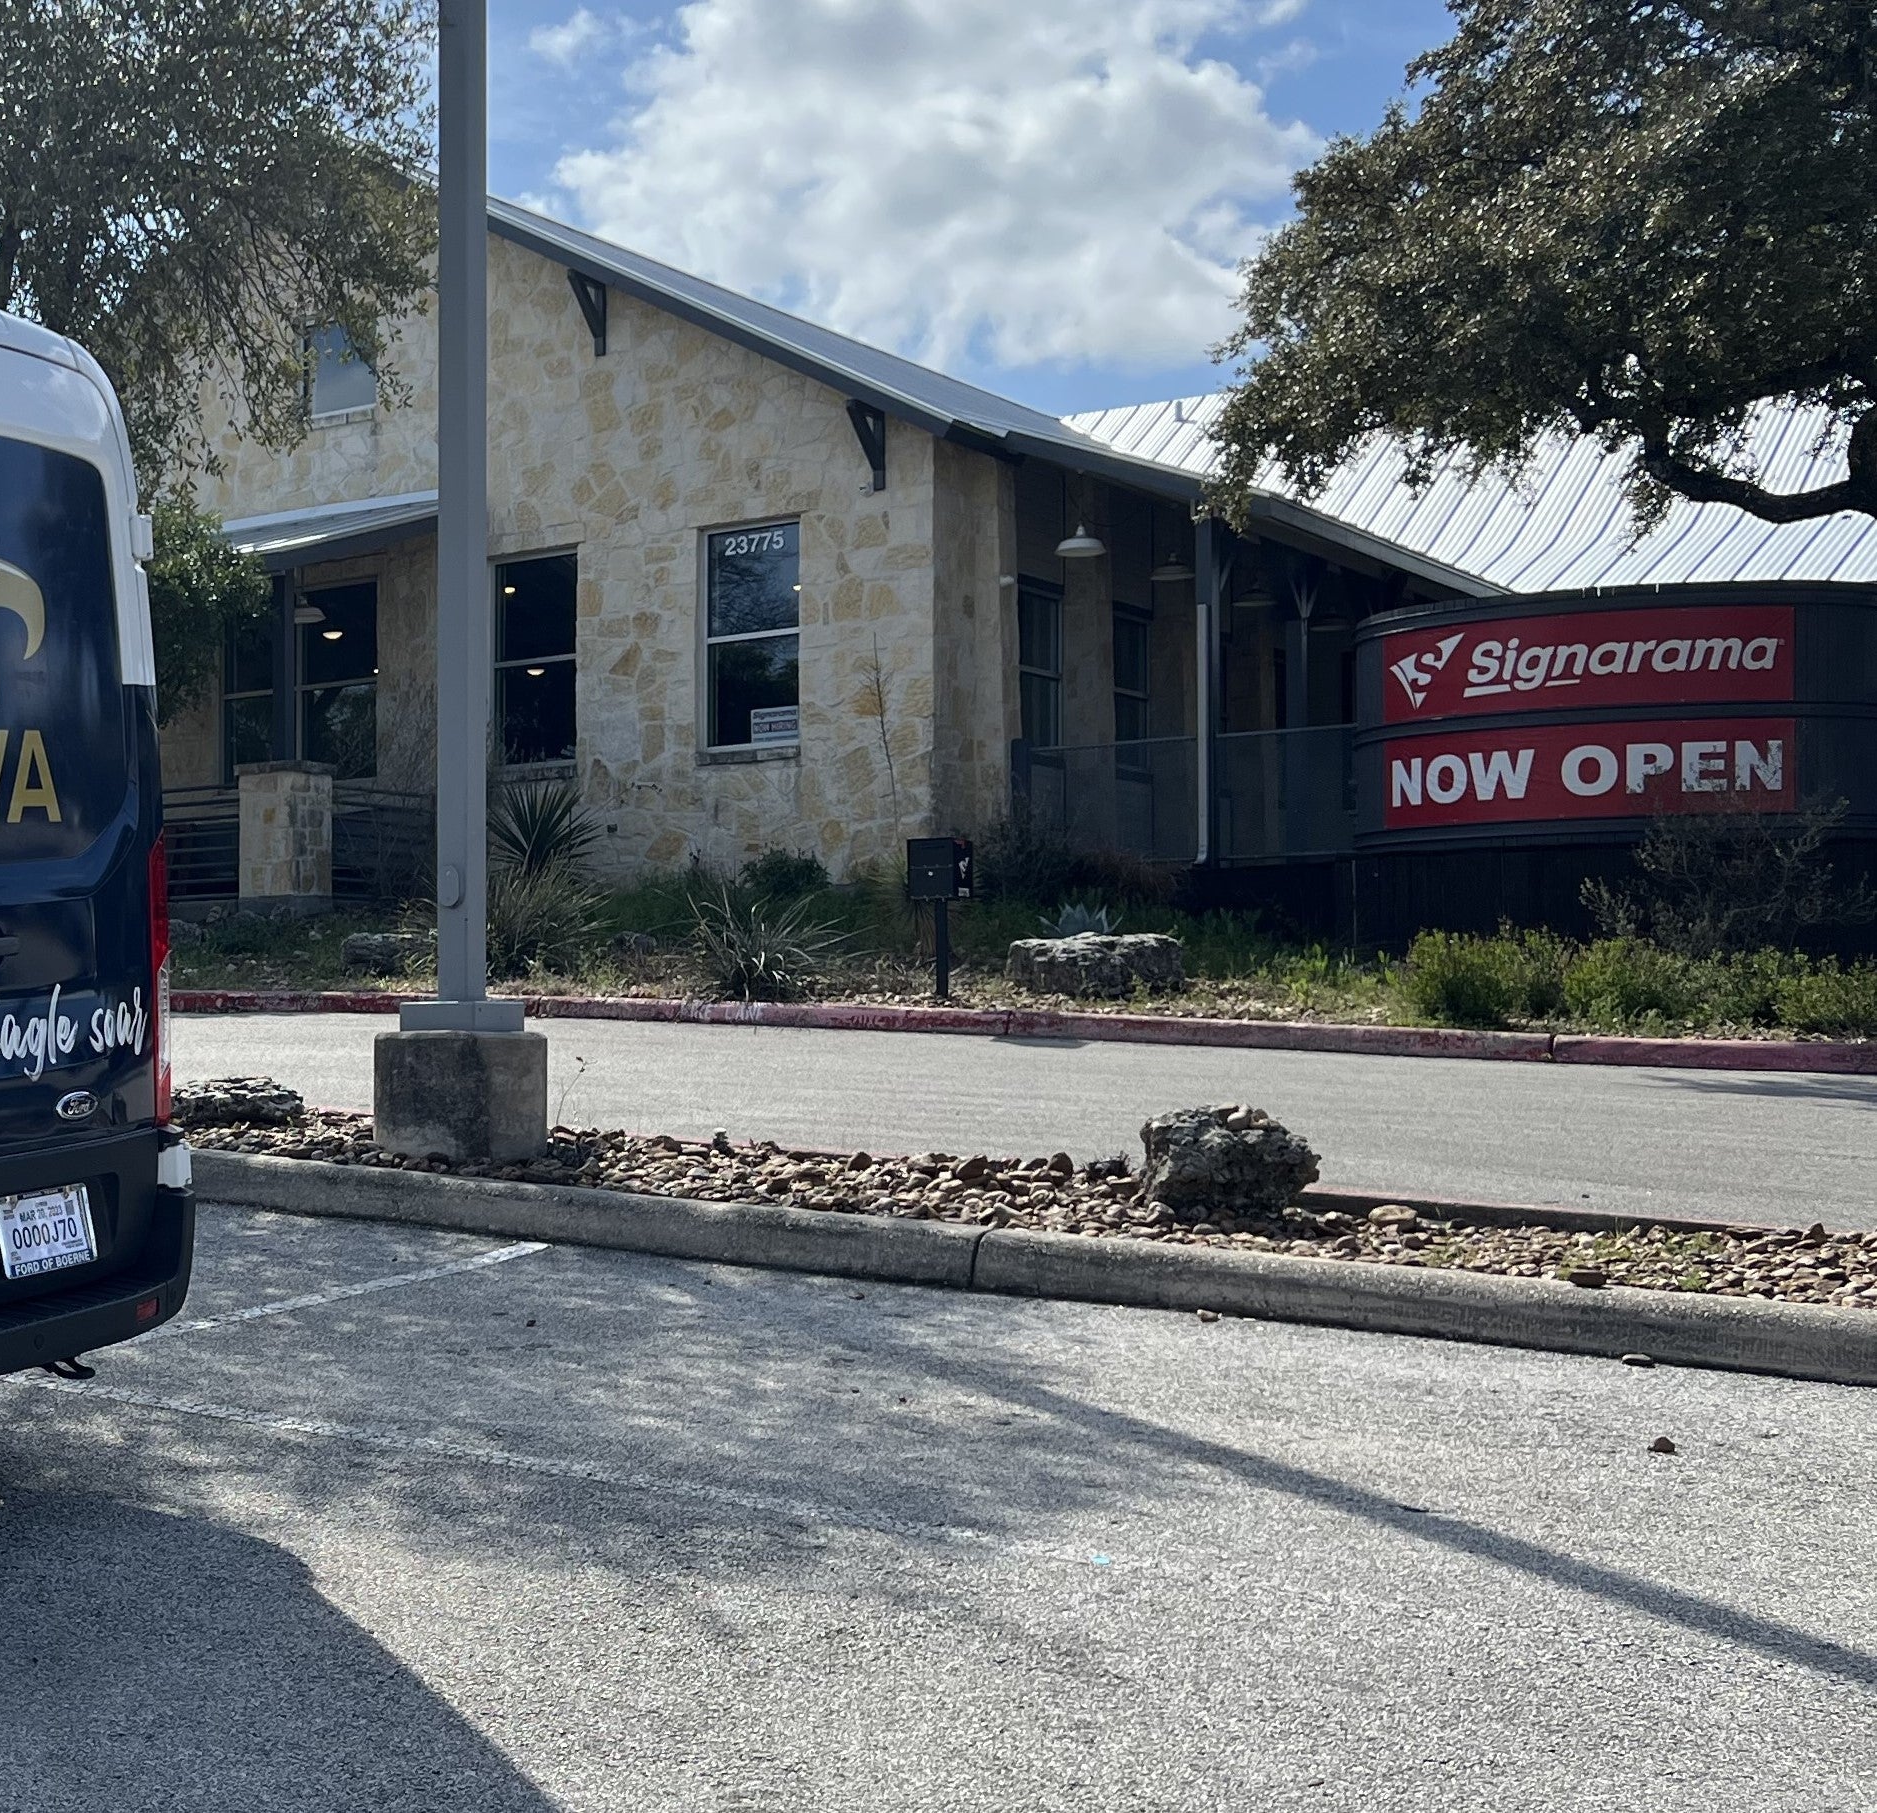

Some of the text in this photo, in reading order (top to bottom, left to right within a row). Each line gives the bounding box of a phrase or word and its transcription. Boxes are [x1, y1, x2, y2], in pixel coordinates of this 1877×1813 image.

[725, 530, 785, 556] 23775
[1465, 636, 1778, 695] Signarama
[1391, 739, 1784, 808] NOW OPEN
[89, 985, 148, 1056] soar
[19, 1208, 37, 1222] MAR
[14, 1261, 41, 1277] FORD
[41, 1256, 55, 1270] OF
[55, 1250, 91, 1268] BOERNE
